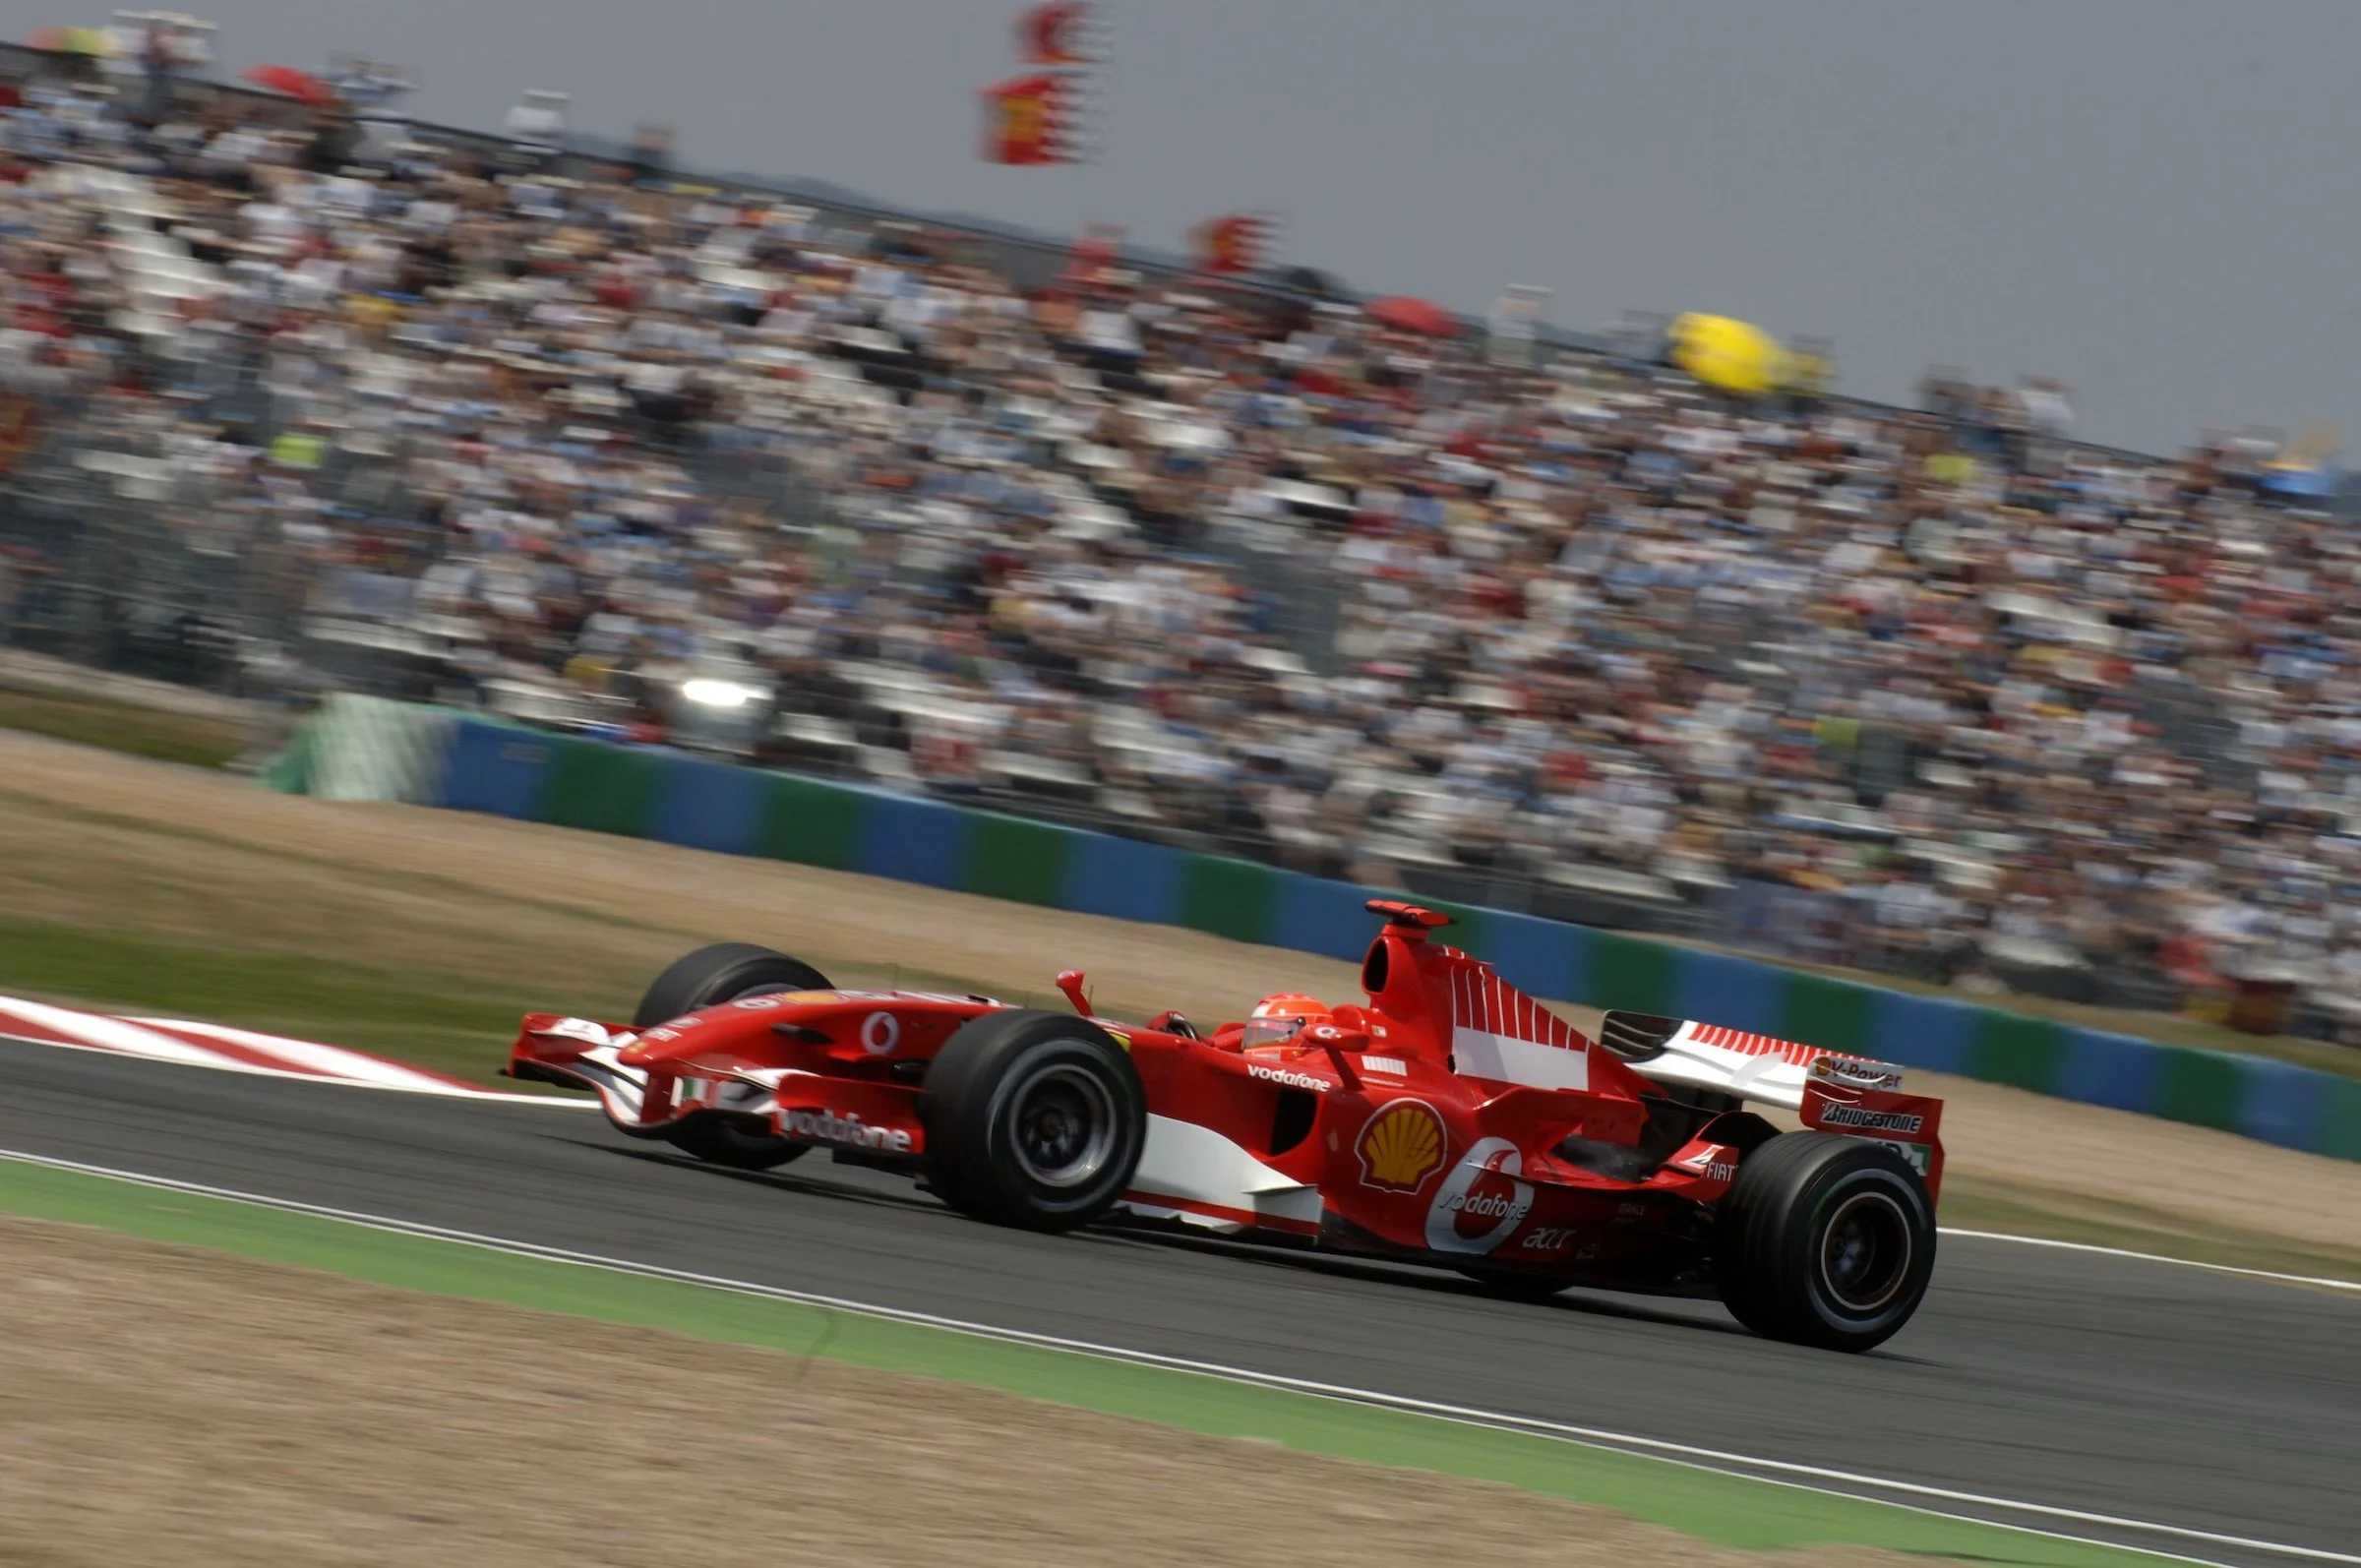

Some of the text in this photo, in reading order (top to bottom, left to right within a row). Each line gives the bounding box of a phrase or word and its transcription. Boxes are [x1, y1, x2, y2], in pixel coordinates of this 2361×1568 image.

[1246, 1063, 1331, 1093] vodafone
[1831, 1060, 1903, 1088] V-Power
[779, 1108, 912, 1152] vodafone
[1822, 1103, 1922, 1132] BRIDGESTONE
[1707, 1162, 1735, 1182] FIAT
[1438, 1190, 1528, 1220] vodafone
[1523, 1227, 1577, 1249] acer
